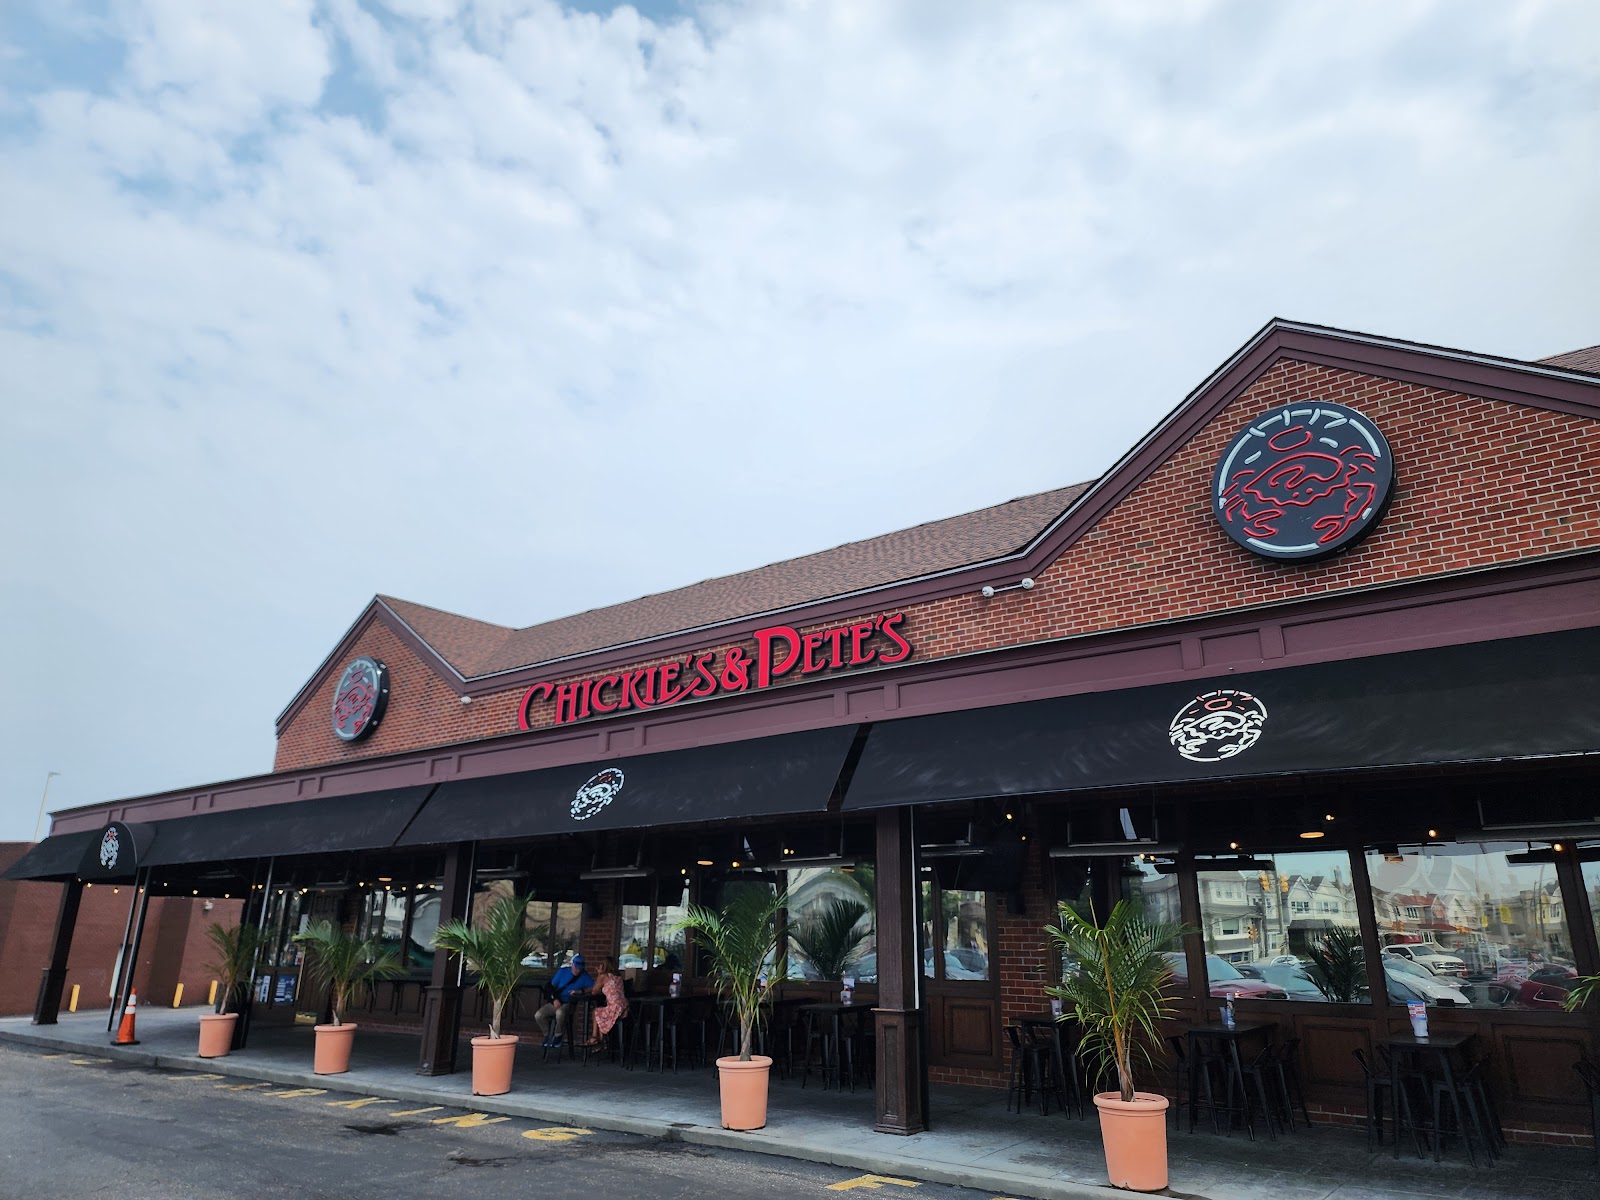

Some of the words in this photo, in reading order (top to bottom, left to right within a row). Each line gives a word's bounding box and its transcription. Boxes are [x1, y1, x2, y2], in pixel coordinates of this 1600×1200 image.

[518, 653, 717, 731] CHICKIE'S
[721, 647, 753, 692] &
[754, 613, 911, 688] PETE'S
